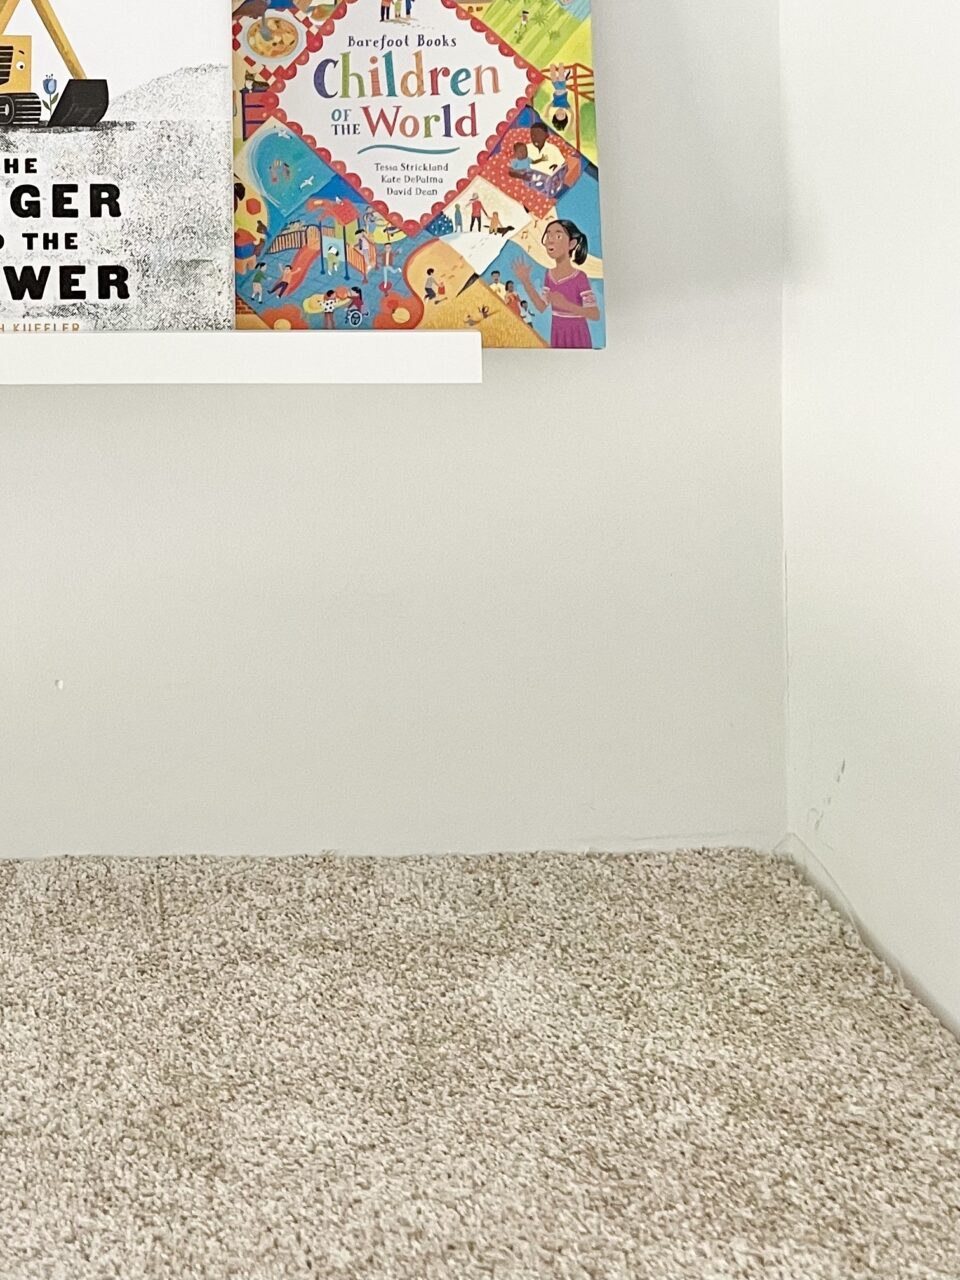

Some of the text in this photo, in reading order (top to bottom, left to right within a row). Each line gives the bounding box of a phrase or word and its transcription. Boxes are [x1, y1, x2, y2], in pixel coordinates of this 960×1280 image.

[348, 34, 457, 49] Barefoot Books
[313, 50, 501, 99] Children
[331, 108, 352, 123] OF
[361, 103, 480, 138] World
[331, 123, 361, 136] THE
[374, 163, 449, 171] Tessa Strickland
[381, 175, 443, 183] Kate DePalma
[22, 232, 78, 250] THE
